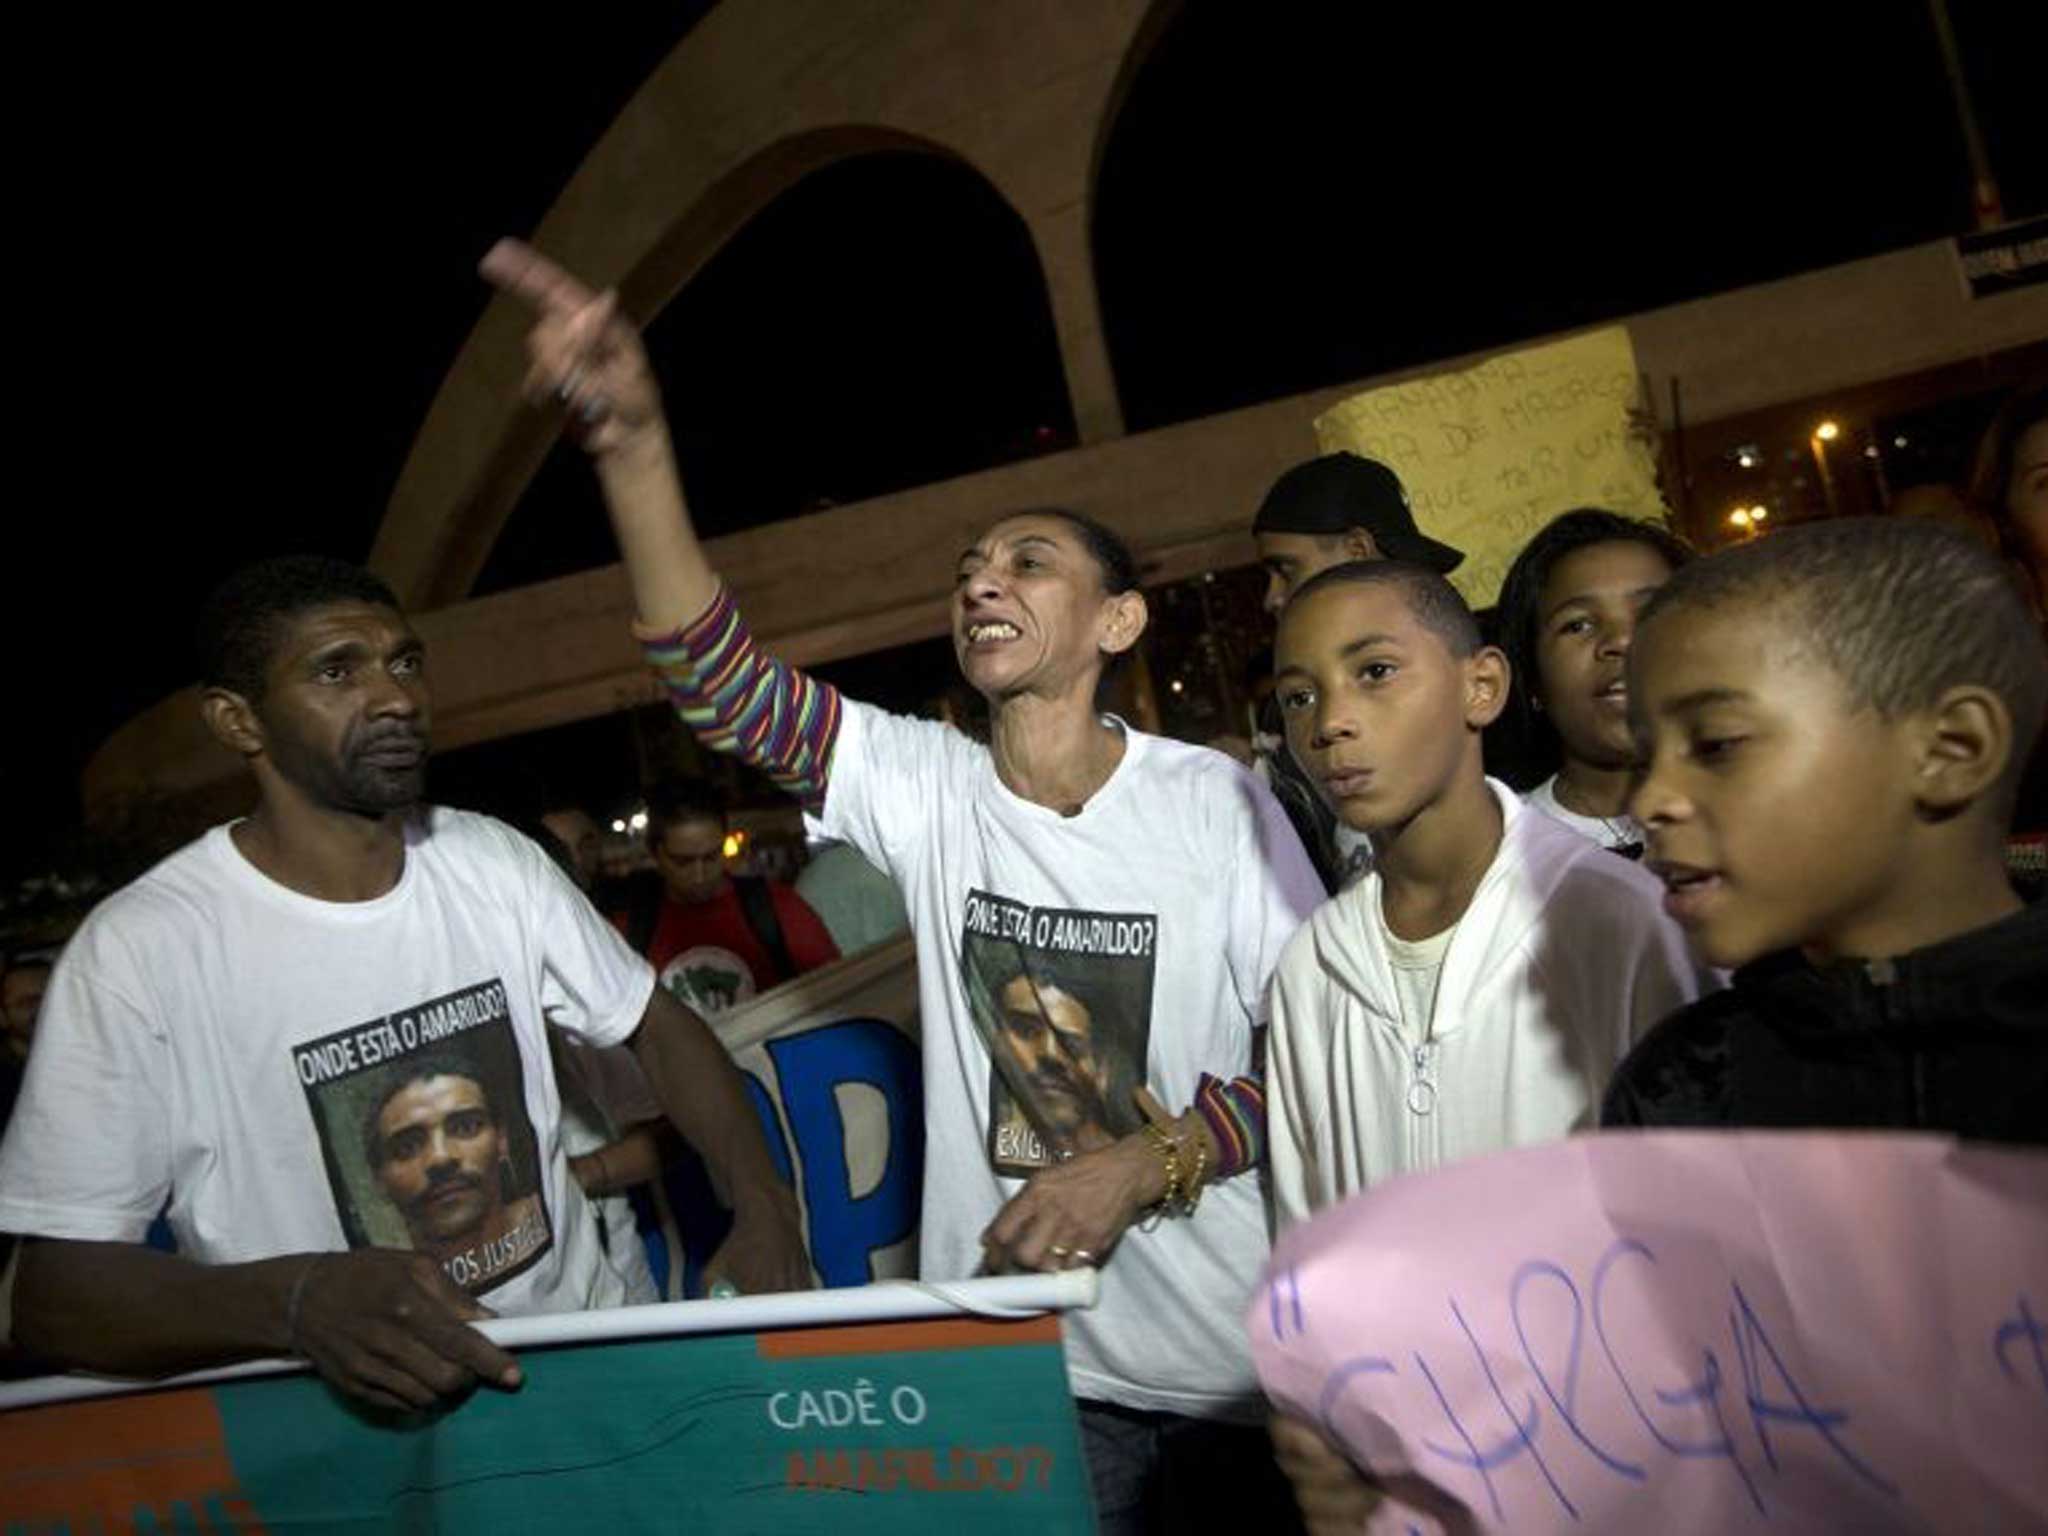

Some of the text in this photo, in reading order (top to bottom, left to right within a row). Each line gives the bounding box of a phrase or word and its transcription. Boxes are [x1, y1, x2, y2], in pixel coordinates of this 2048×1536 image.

[1036, 915, 1051, 948] O
[1052, 916, 1154, 956] AMARILDO?
[297, 984, 508, 1086] ONDE ESTÁ O AMARILDO?
[767, 1377, 928, 1431] CADÊ O
[787, 1444, 1058, 1493] AMARILDO?
